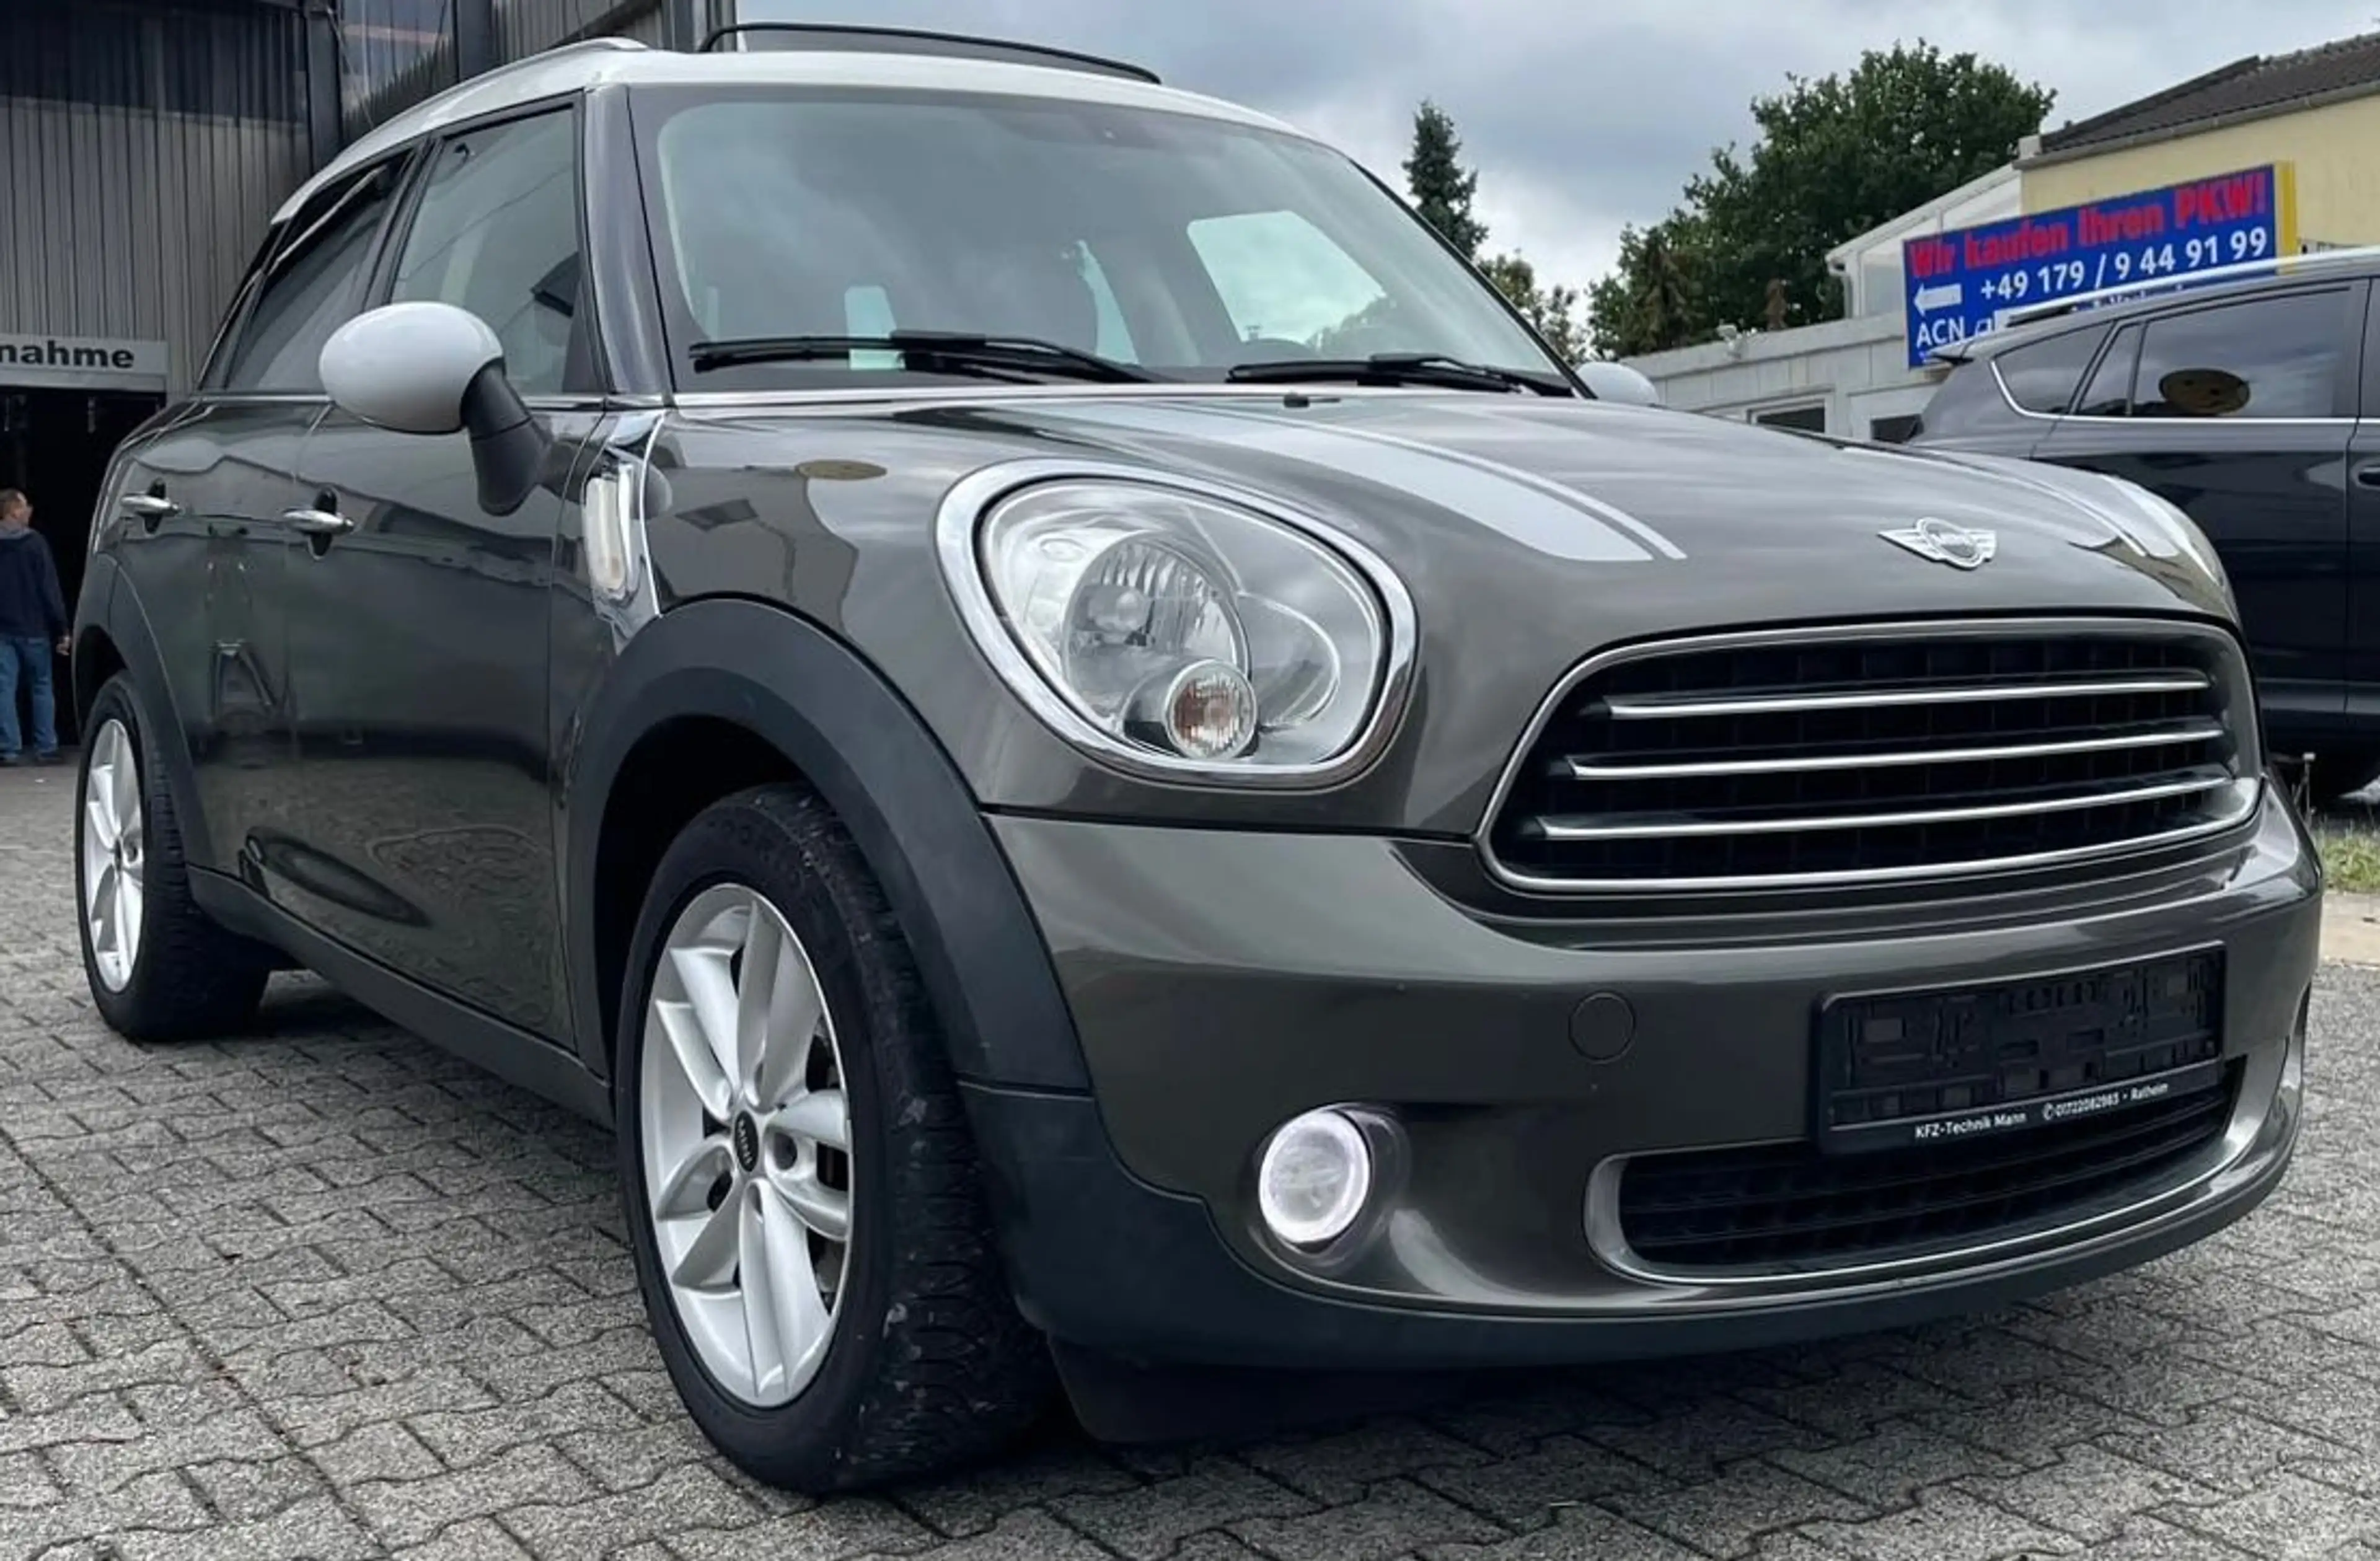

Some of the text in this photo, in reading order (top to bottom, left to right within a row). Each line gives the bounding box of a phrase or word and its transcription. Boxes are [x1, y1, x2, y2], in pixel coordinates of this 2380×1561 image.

[1909, 172, 2265, 277] Wir kaufen Ihren PKW!
[1981, 226, 2267, 299] +49 179 / 9 44 91 99
[1916, 315, 1965, 348] ACN
[0, 340, 134, 369] nahme
[1915, 1115, 1991, 1138] KFZ-Technik
[1994, 1113, 2027, 1127] Mann
